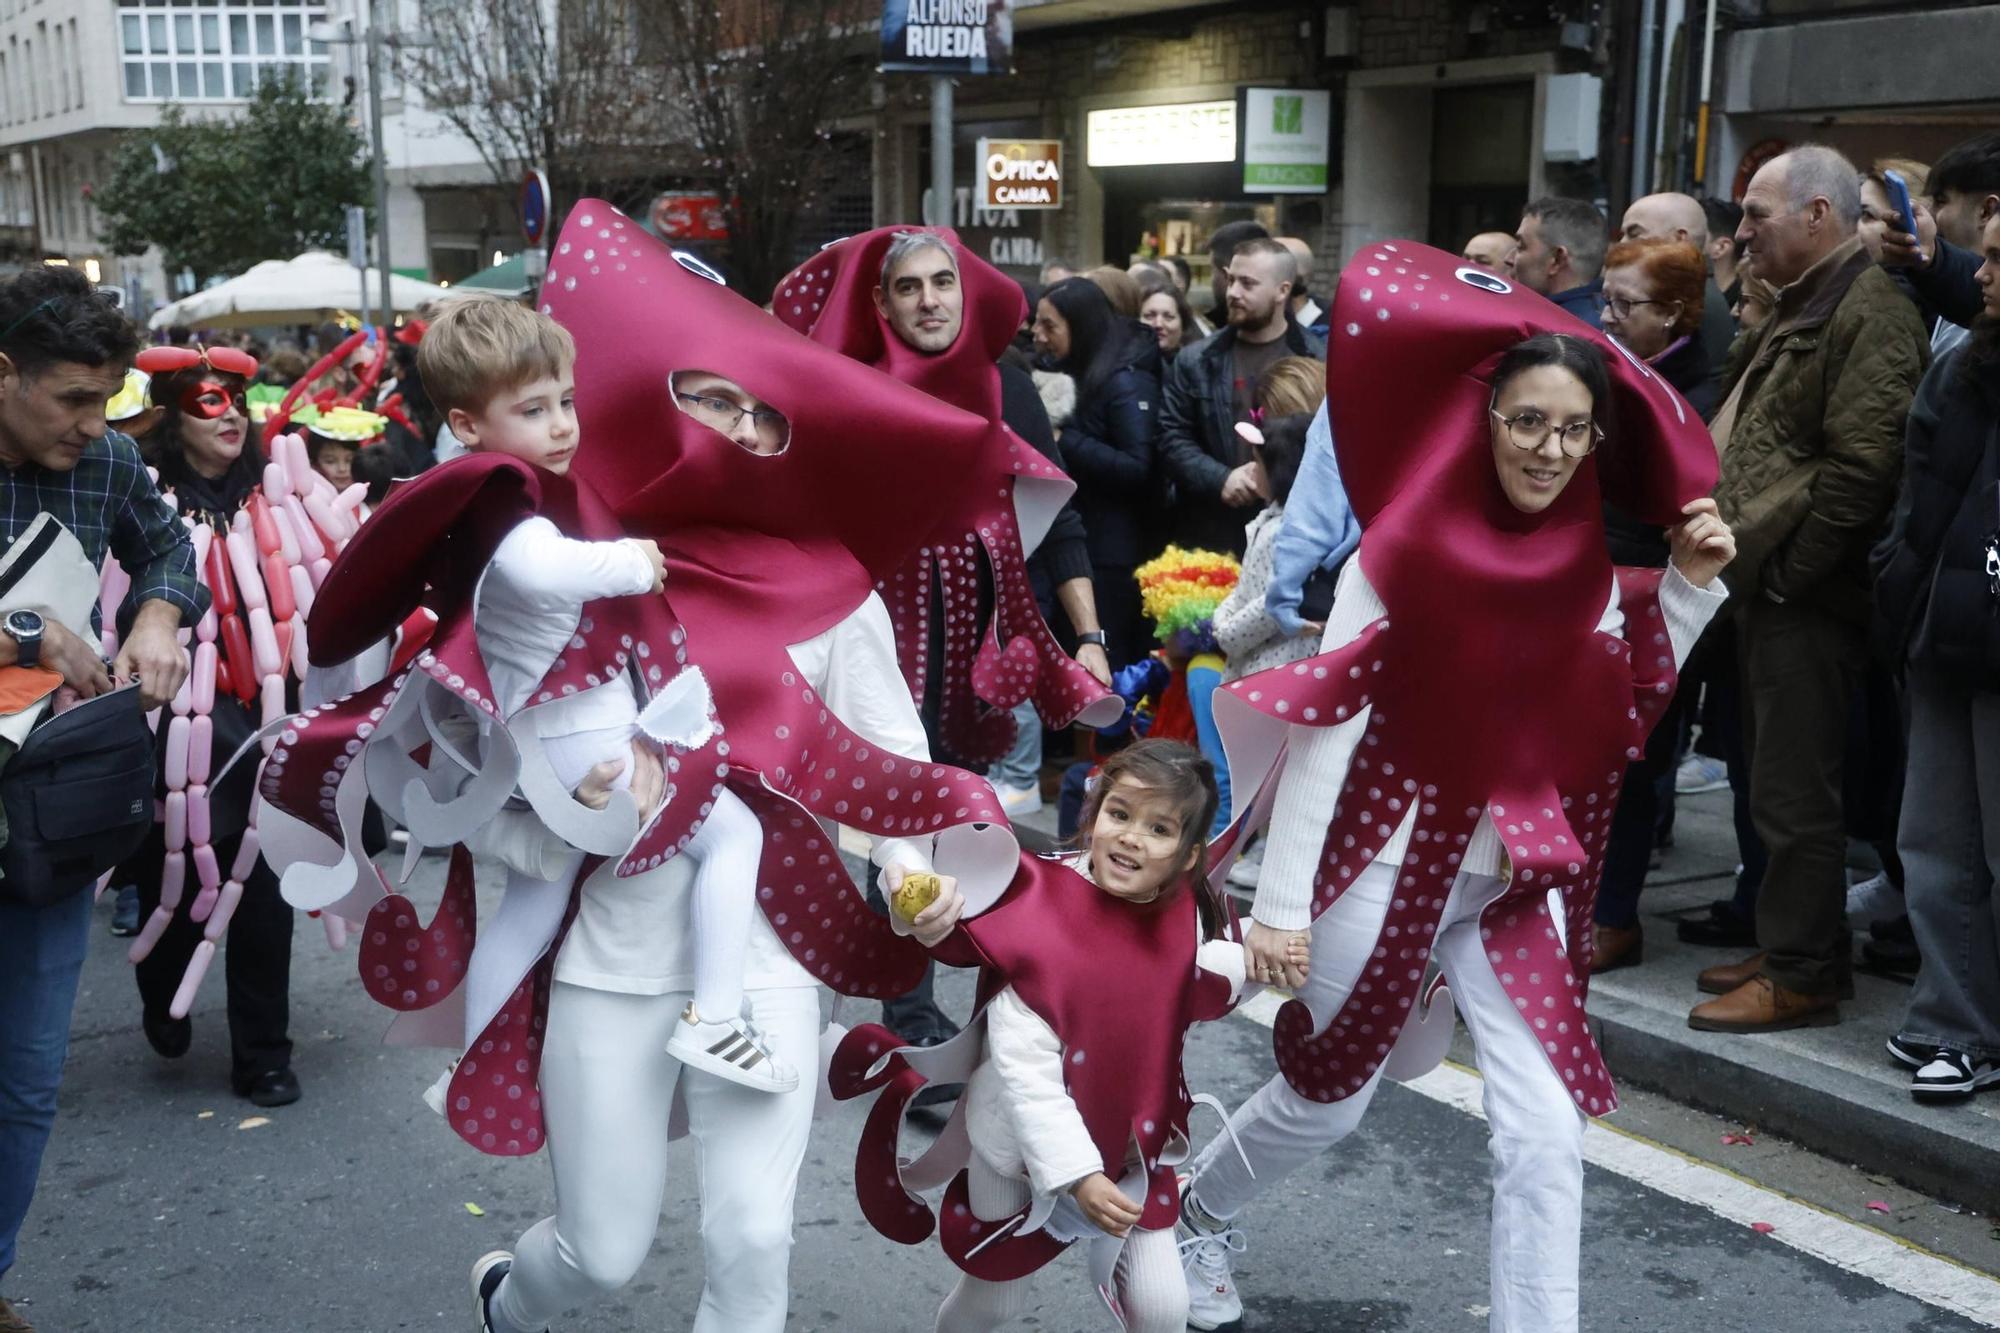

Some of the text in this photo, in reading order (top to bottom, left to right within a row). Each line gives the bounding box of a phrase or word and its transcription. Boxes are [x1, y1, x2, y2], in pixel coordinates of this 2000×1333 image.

[907, 0, 987, 25] ALFONSO
[906, 25, 987, 58] RUEDA
[995, 186, 1051, 203] CAMBA
